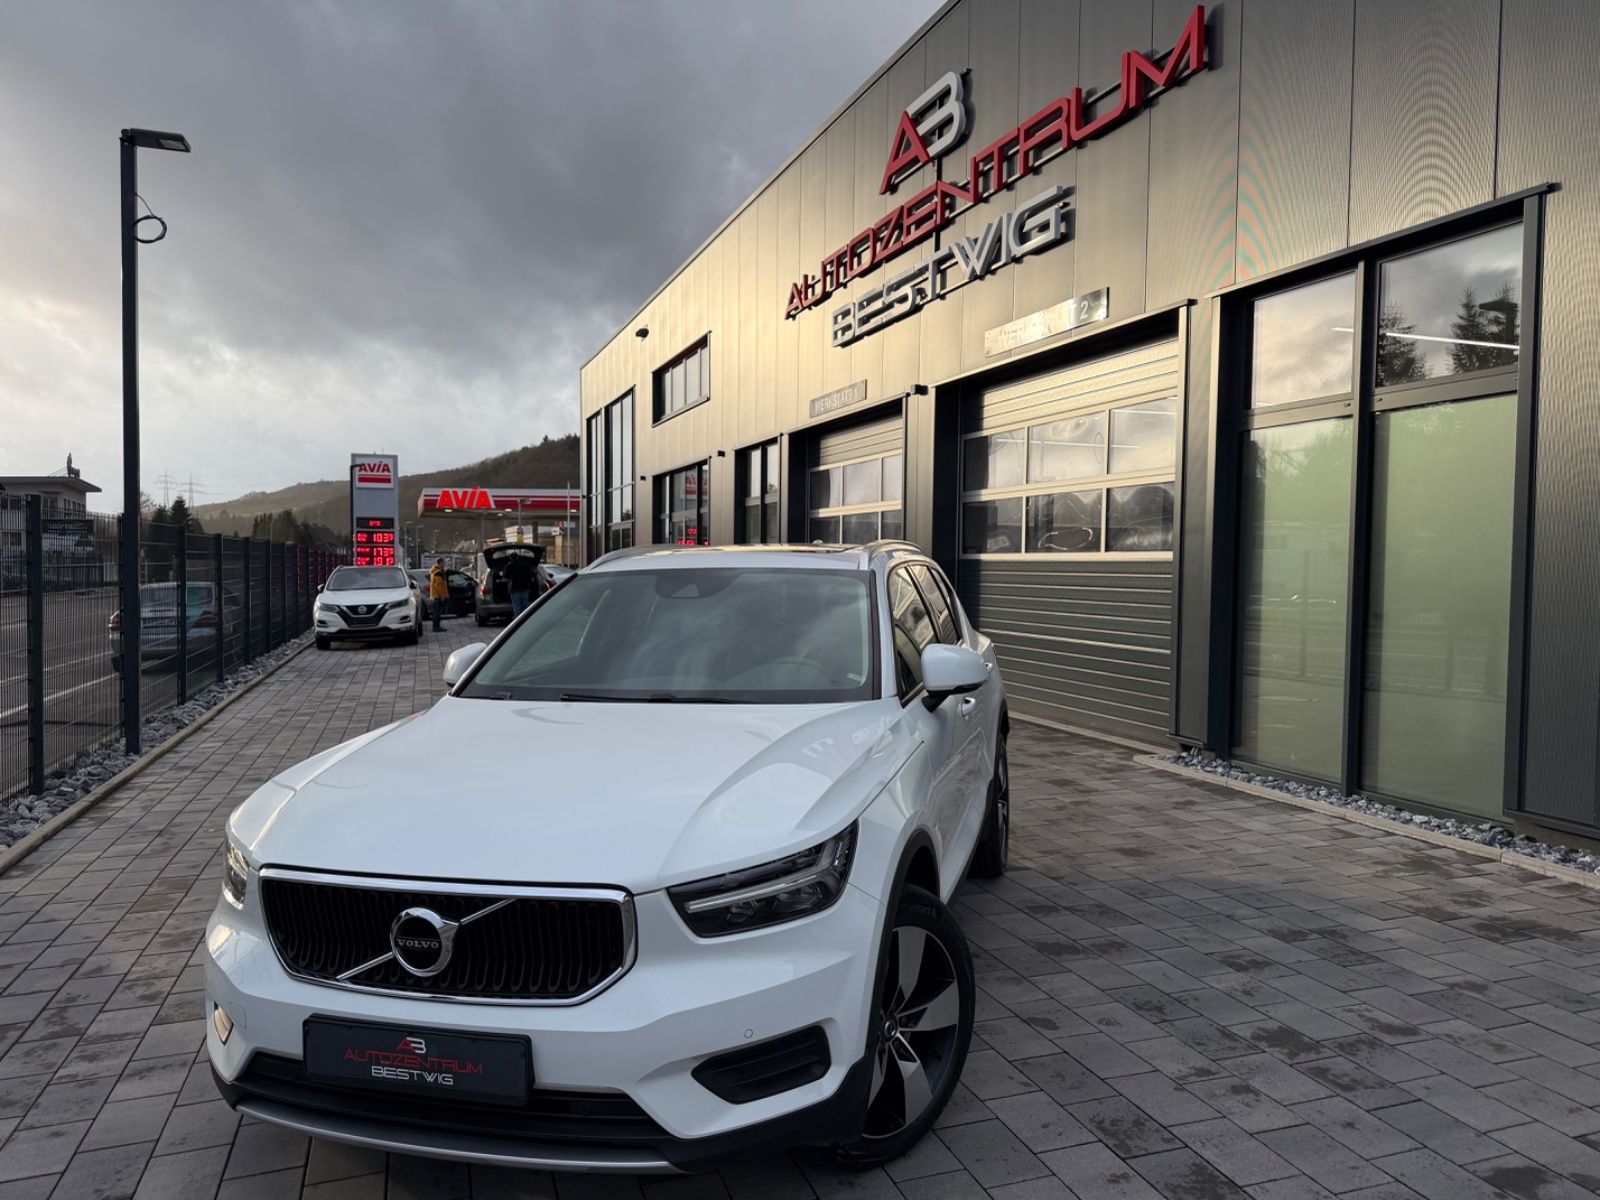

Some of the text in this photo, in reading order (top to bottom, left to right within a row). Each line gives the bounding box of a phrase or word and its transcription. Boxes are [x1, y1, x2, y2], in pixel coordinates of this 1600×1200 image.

[784, 3, 1206, 320] AUTOZENTRUM
[831, 185, 1063, 347] BESTWIG
[1080, 301, 1088, 320] 2
[396, 938, 440, 950] VOLVO
[343, 1048, 483, 1074] AUTOZENTRUM
[371, 1065, 454, 1086] BESTWIG
